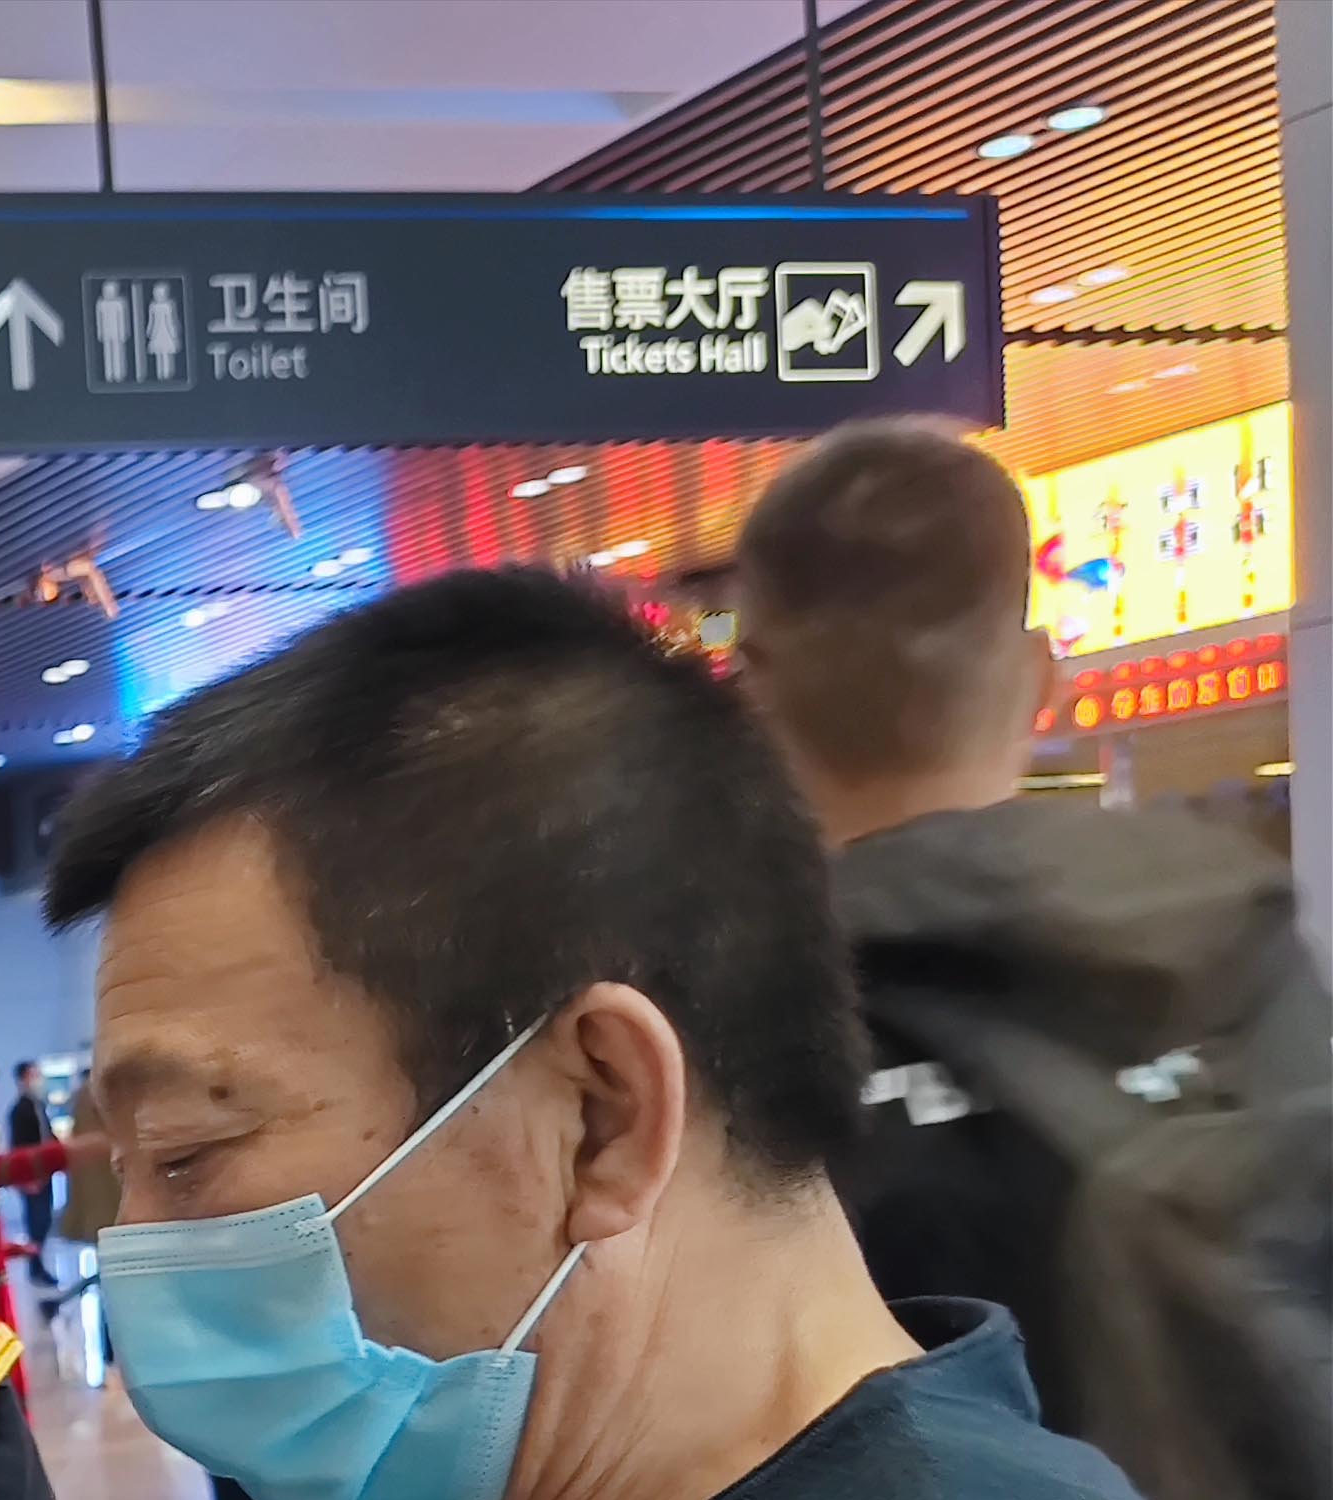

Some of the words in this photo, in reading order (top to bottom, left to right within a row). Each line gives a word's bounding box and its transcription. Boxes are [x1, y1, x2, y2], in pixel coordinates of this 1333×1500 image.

[207, 270, 369, 334] 卫生间
[560, 265, 770, 331] 售票大厅
[206, 341, 310, 381] Toilet
[579, 332, 697, 374] Tickets
[699, 331, 768, 373] Hall
